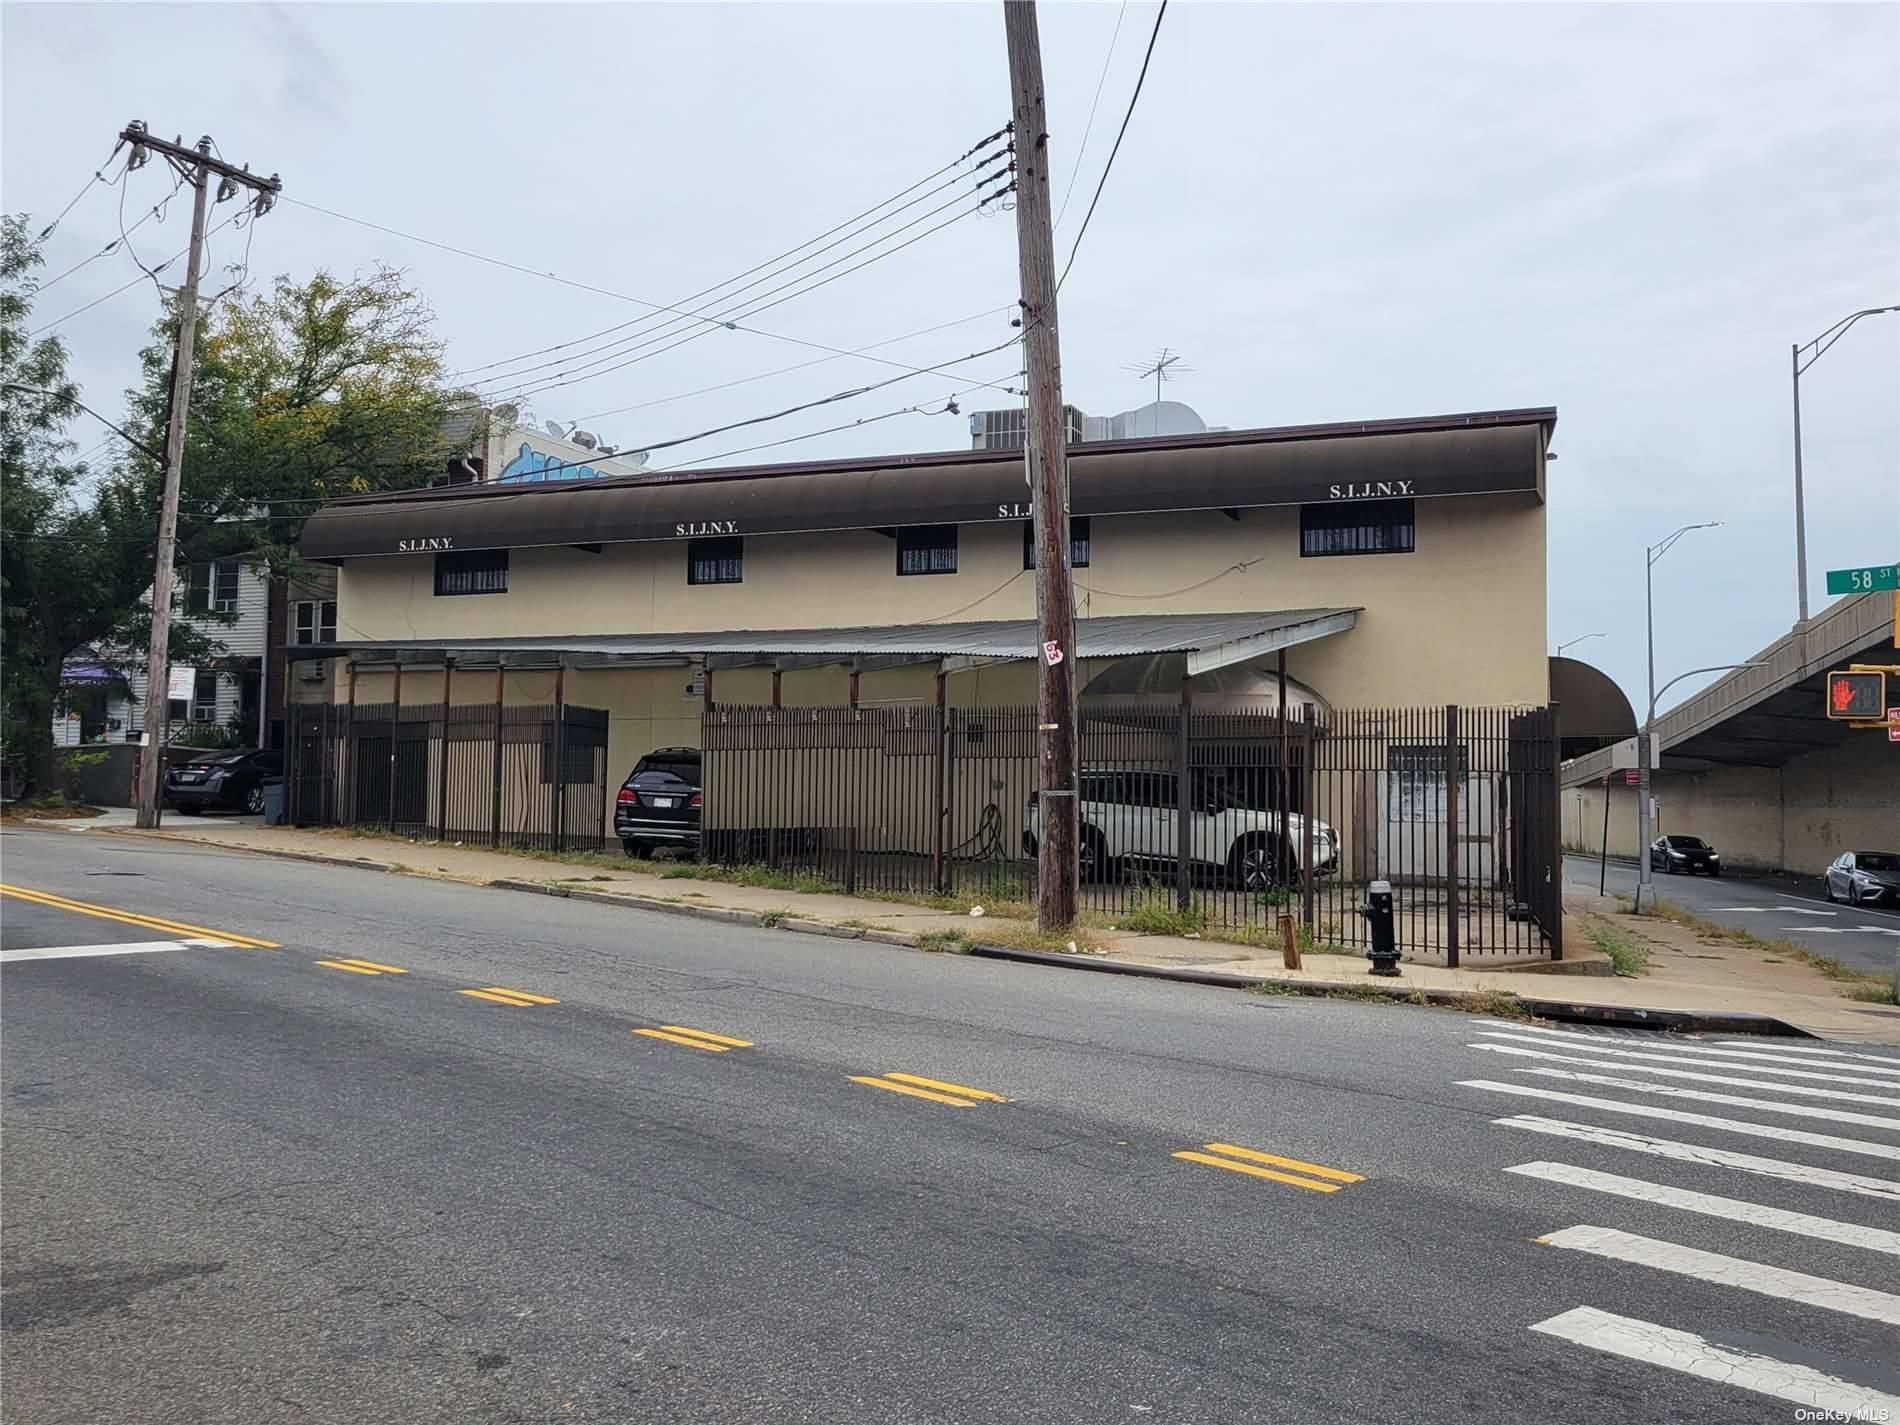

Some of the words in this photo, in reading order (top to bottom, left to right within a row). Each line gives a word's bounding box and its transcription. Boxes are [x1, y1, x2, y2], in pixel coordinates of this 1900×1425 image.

[1330, 480, 1414, 499] S.I.J.N.Y.
[998, 502, 1033, 518] S.I.J
[676, 520, 738, 536] S.I.J.N.Y.
[399, 537, 453, 552] S.I.J.N.Y.
[1851, 570, 1873, 590] 58
[1879, 567, 1891, 578] ST
